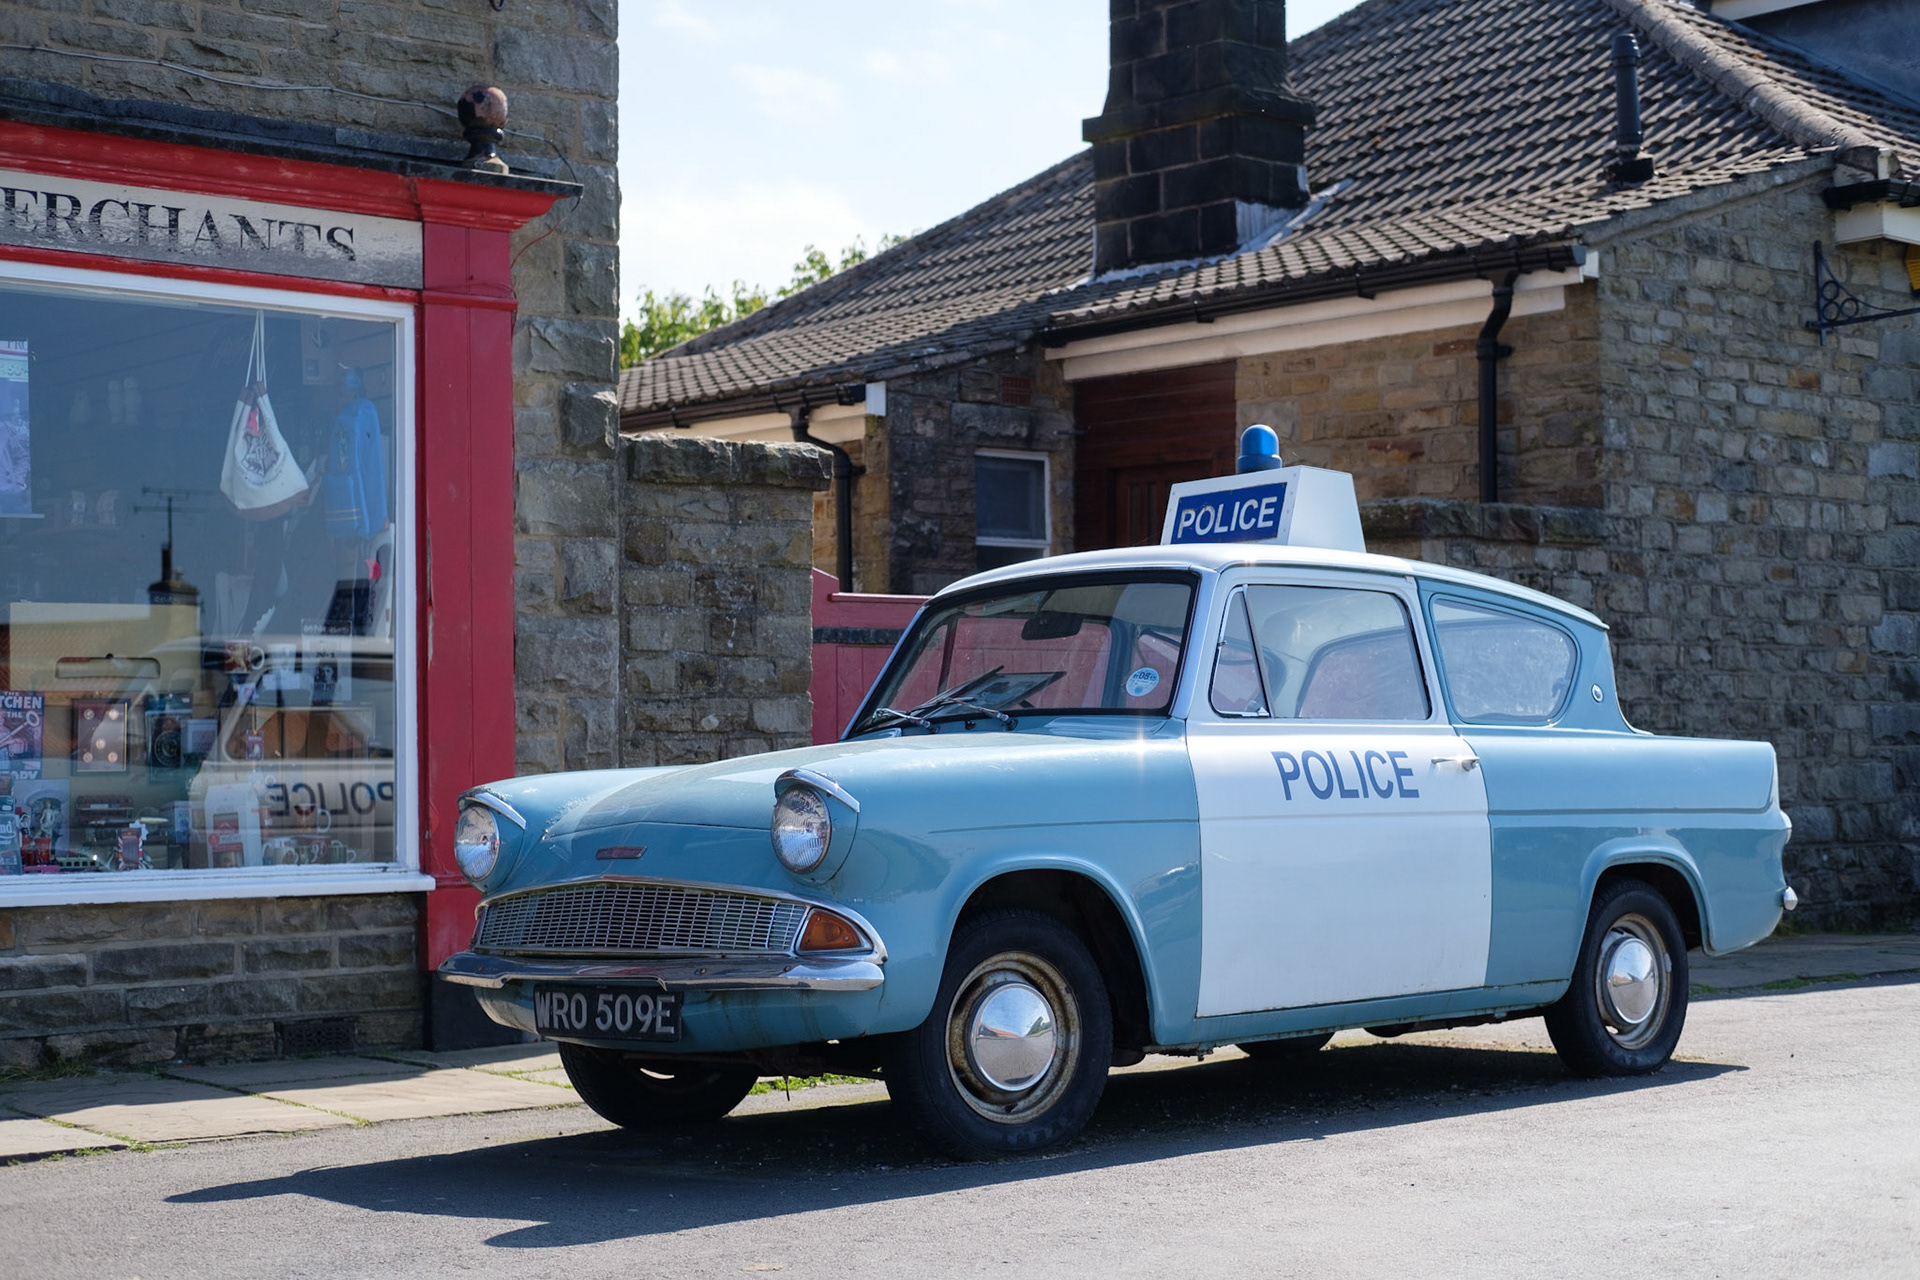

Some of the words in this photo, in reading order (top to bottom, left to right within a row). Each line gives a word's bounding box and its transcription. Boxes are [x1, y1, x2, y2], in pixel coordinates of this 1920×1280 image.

[1177, 496, 1277, 539] POLICE
[1271, 750, 1420, 801] POLICE
[534, 991, 587, 1030] WRO
[595, 993, 675, 1034] 509E
